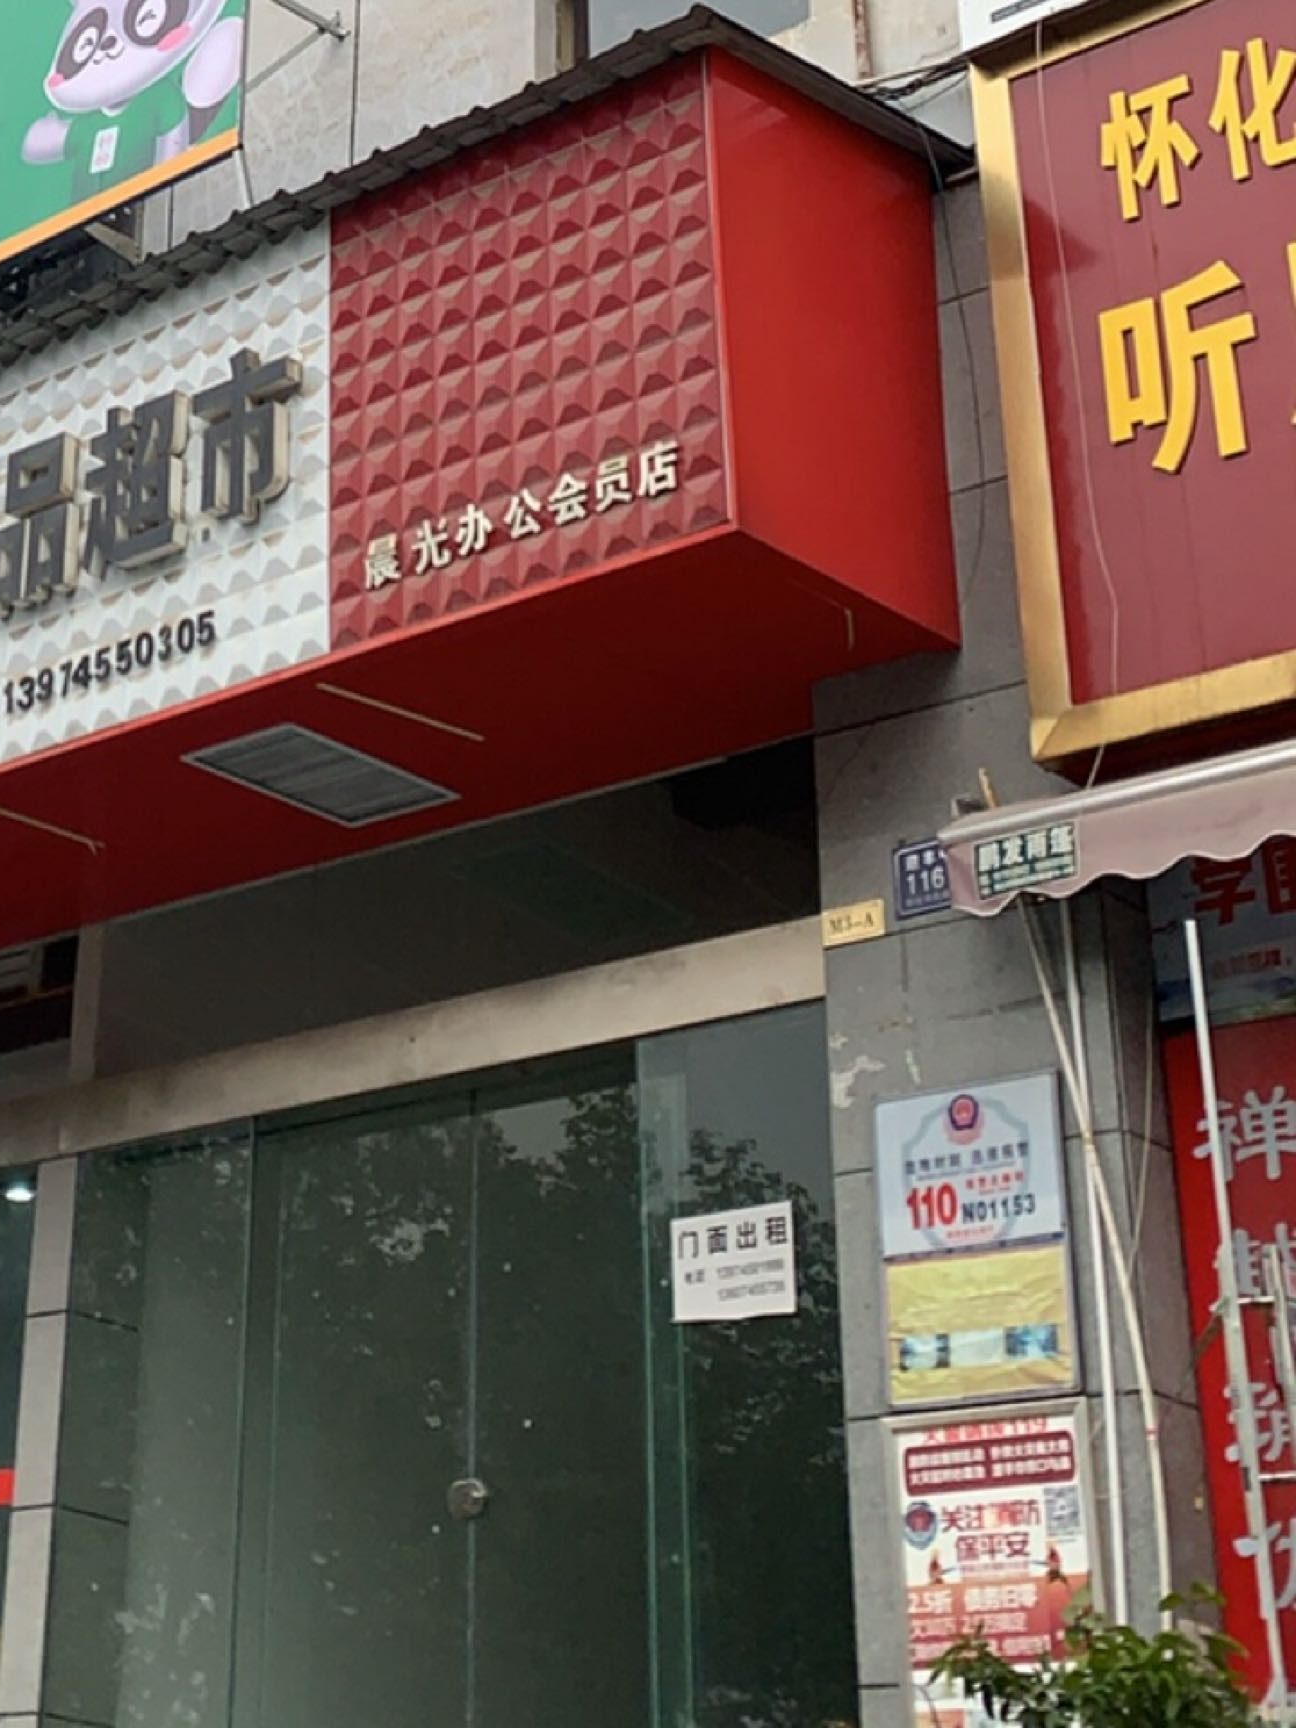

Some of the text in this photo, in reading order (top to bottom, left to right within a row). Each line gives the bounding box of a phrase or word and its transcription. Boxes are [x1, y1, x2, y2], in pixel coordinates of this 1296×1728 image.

[363, 440, 682, 592] 晨光办公会员店
[906, 1182, 958, 1230] 110
[677, 1215, 788, 1260] 门面出租
